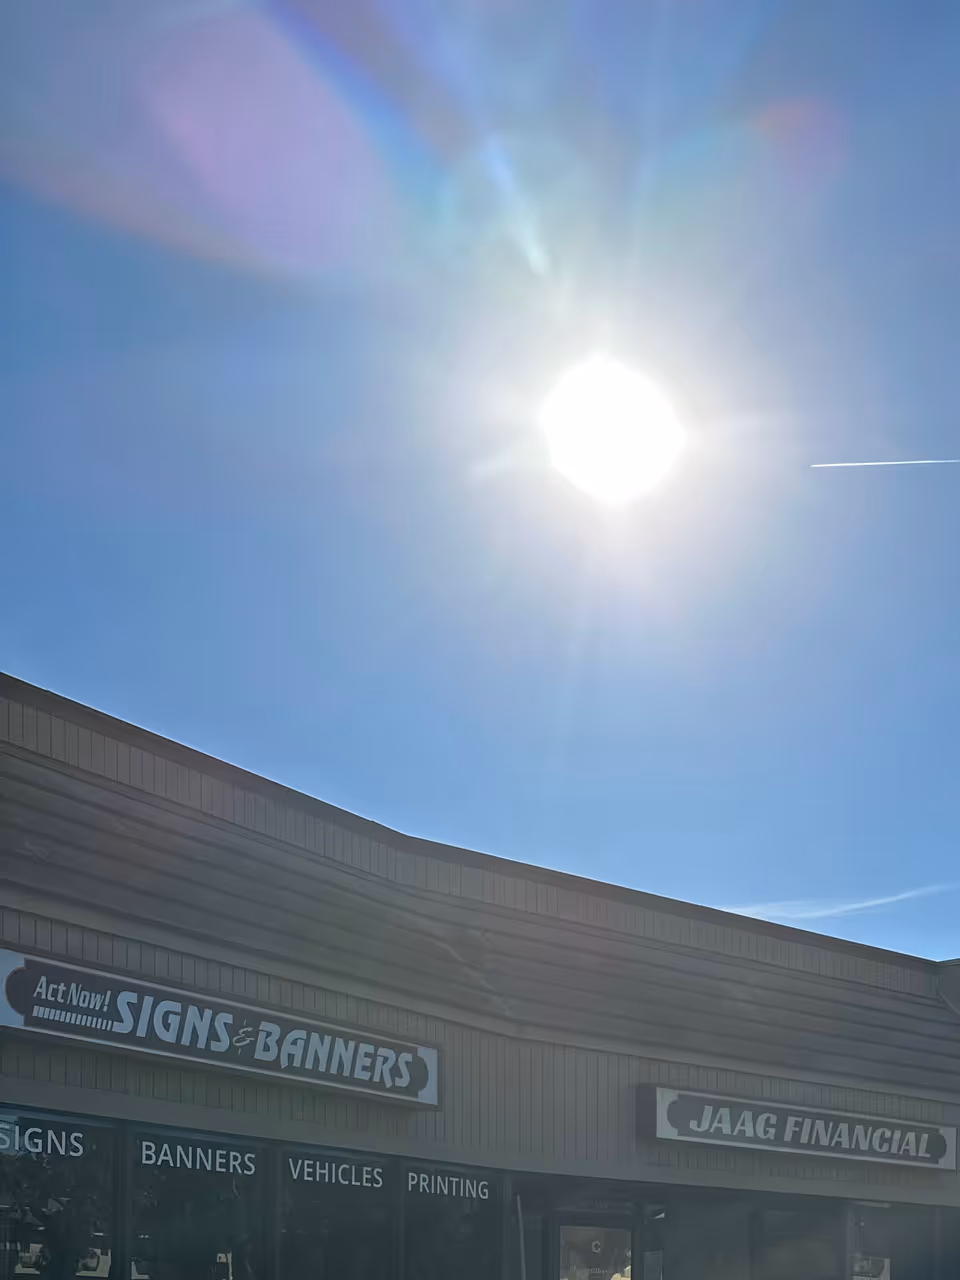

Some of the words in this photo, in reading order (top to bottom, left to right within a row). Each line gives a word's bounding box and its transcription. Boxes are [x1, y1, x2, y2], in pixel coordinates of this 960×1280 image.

[33, 975, 68, 1002] Act
[68, 983, 112, 1012] Now!
[113, 990, 234, 1053] SIGNS
[232, 1018, 256, 1056] &
[254, 1021, 413, 1089] BANNERS
[0, 1125, 84, 1157] SIGNS
[689, 1105, 778, 1140] JAAG
[783, 1116, 931, 1158] FINANCIAL
[141, 1140, 257, 1176] BANNERS
[288, 1158, 384, 1188] VEHICLES
[408, 1172, 489, 1200] PRINTING
